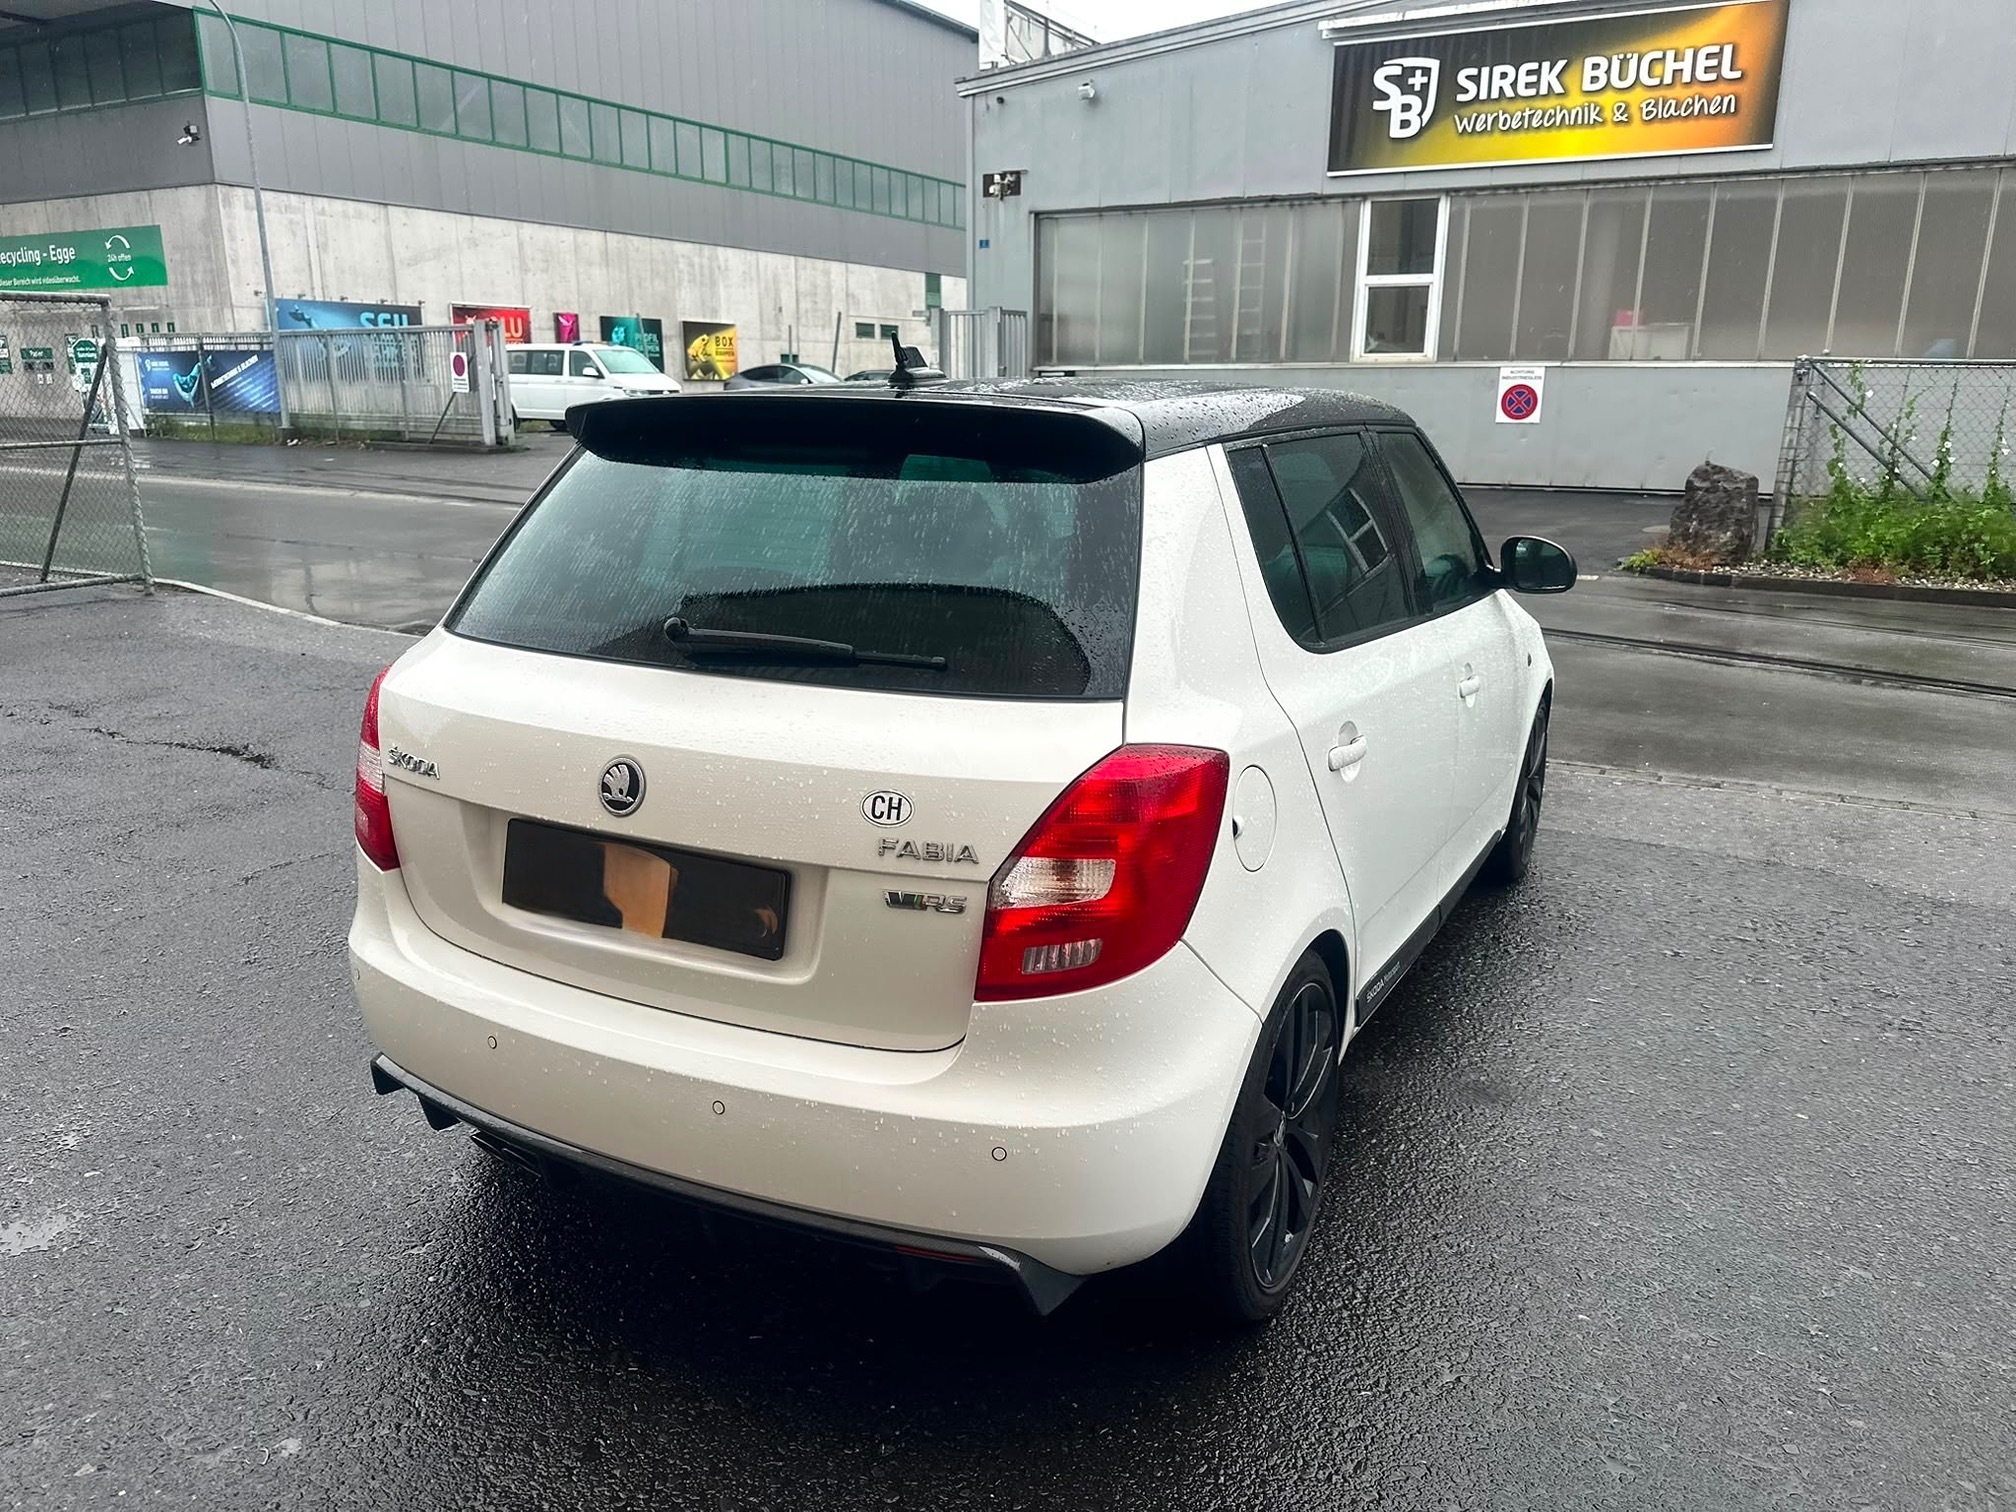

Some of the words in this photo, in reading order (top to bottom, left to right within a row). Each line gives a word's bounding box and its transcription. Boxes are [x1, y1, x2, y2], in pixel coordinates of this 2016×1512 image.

[1455, 59, 1568, 102] SIREK
[1581, 43, 1743, 92] BÜCHEL
[1454, 102, 1603, 135] Werbetechnik
[1612, 103, 1629, 122] &
[1641, 92, 1736, 121] Blachen
[0, 246, 41, 267] ecycling
[49, 244, 76, 264] Egge
[118, 252, 132, 262] offen
[715, 335, 734, 347] BOX
[871, 795, 903, 820] CH
[877, 837, 980, 864] FABIA
